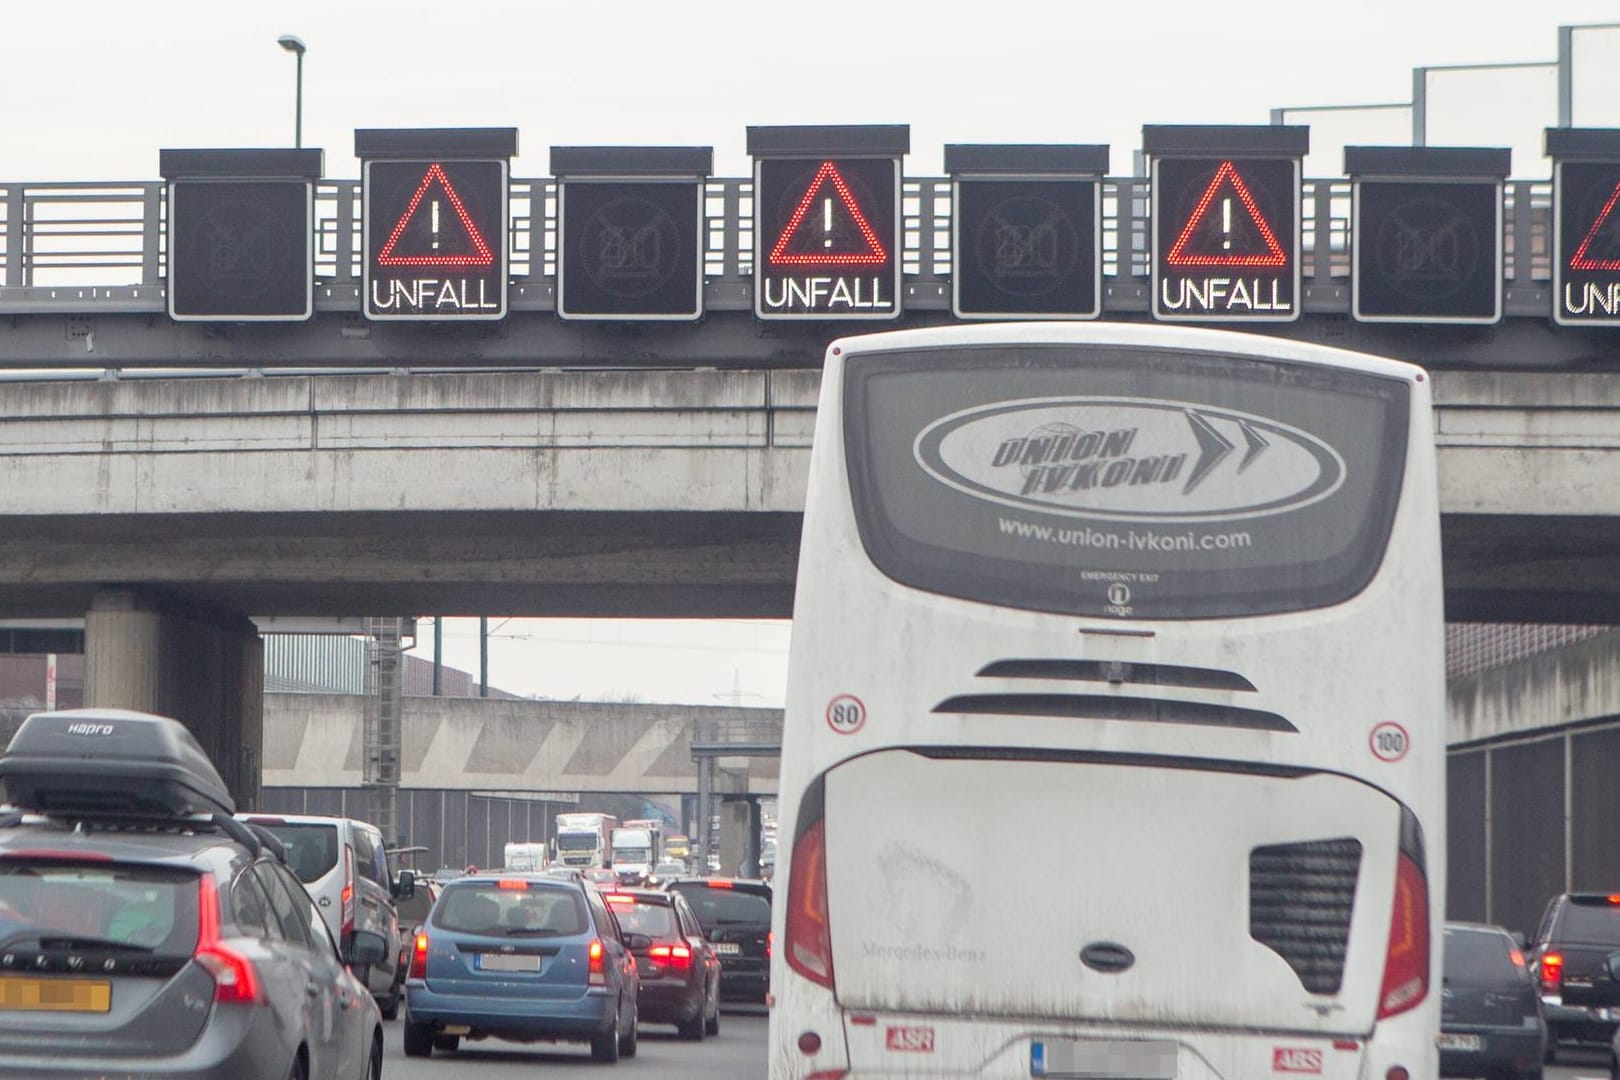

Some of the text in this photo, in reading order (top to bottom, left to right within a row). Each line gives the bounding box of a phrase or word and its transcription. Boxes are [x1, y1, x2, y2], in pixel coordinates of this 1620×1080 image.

[372, 279, 497, 310] UNFALL
[764, 277, 892, 309] UNFALL
[1162, 278, 1291, 310] UNFALL
[992, 428, 1138, 467] UNION
[1021, 453, 1187, 495] IVKONI
[999, 517, 1252, 552] www.union-ivkoni.com
[1080, 571, 1160, 583] EMERGENCY EXIT
[833, 703, 859, 725] 80
[1377, 732, 1403, 753] 100
[890, 1027, 934, 1051] ASR
[1276, 1049, 1323, 1073] ABS
